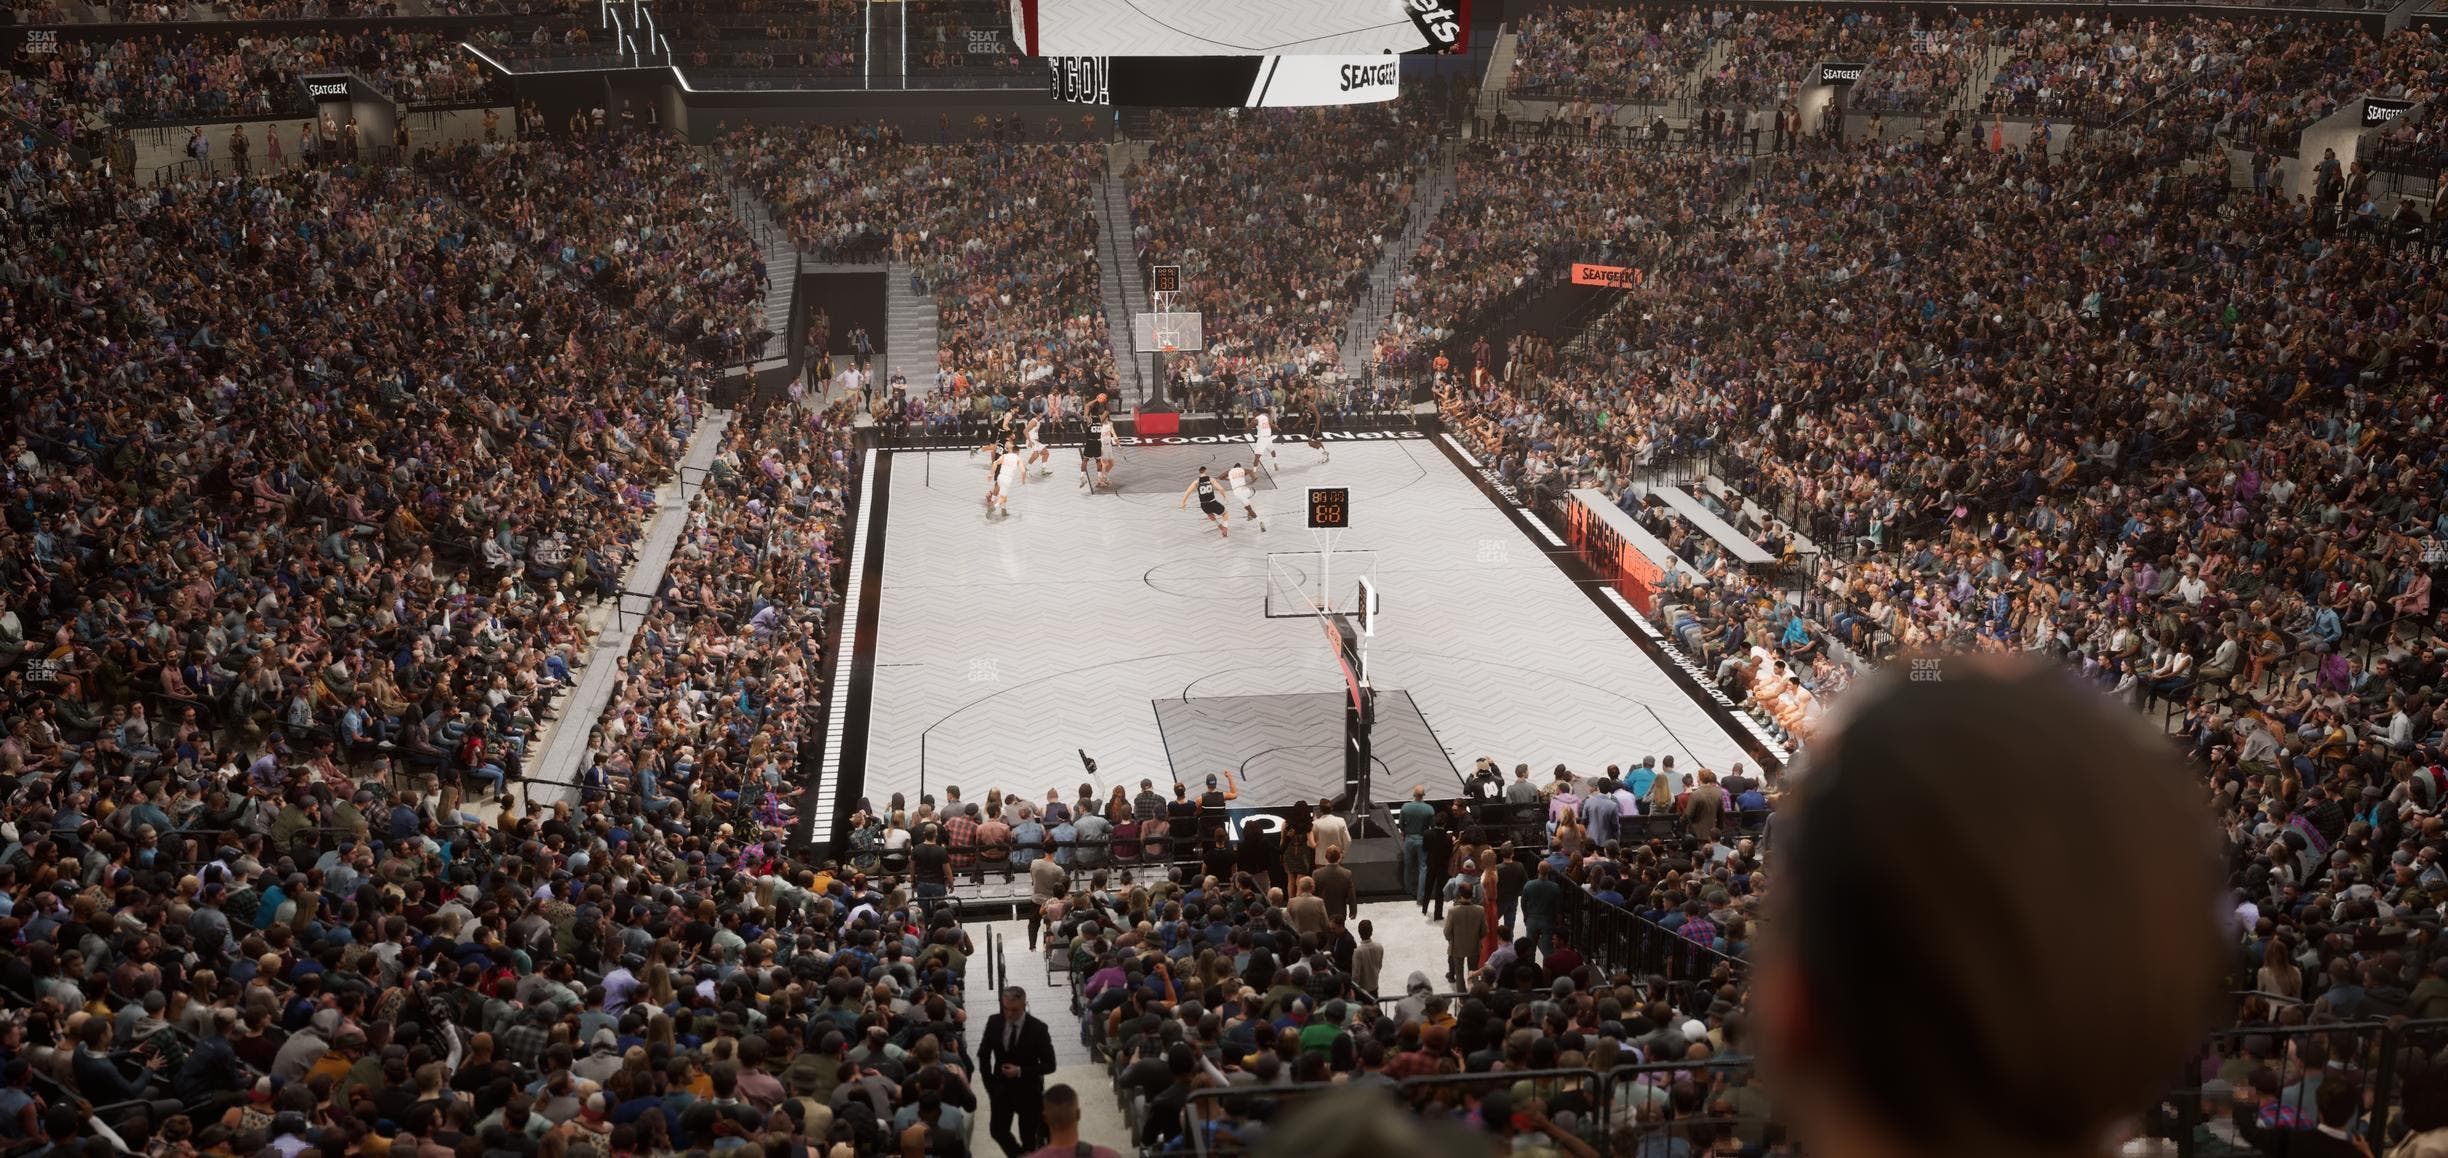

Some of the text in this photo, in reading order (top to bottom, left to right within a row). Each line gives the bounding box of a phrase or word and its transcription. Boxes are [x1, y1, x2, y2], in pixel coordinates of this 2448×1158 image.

[1822, 69, 1861, 79] SEATGEEK
[1064, 56, 1109, 105] GO!
[309, 82, 348, 96] SEATGEEK
[2367, 105, 2407, 120] SEATGE
[1321, 431, 1424, 440] Nets
[1200, 484, 1213, 495] 00
